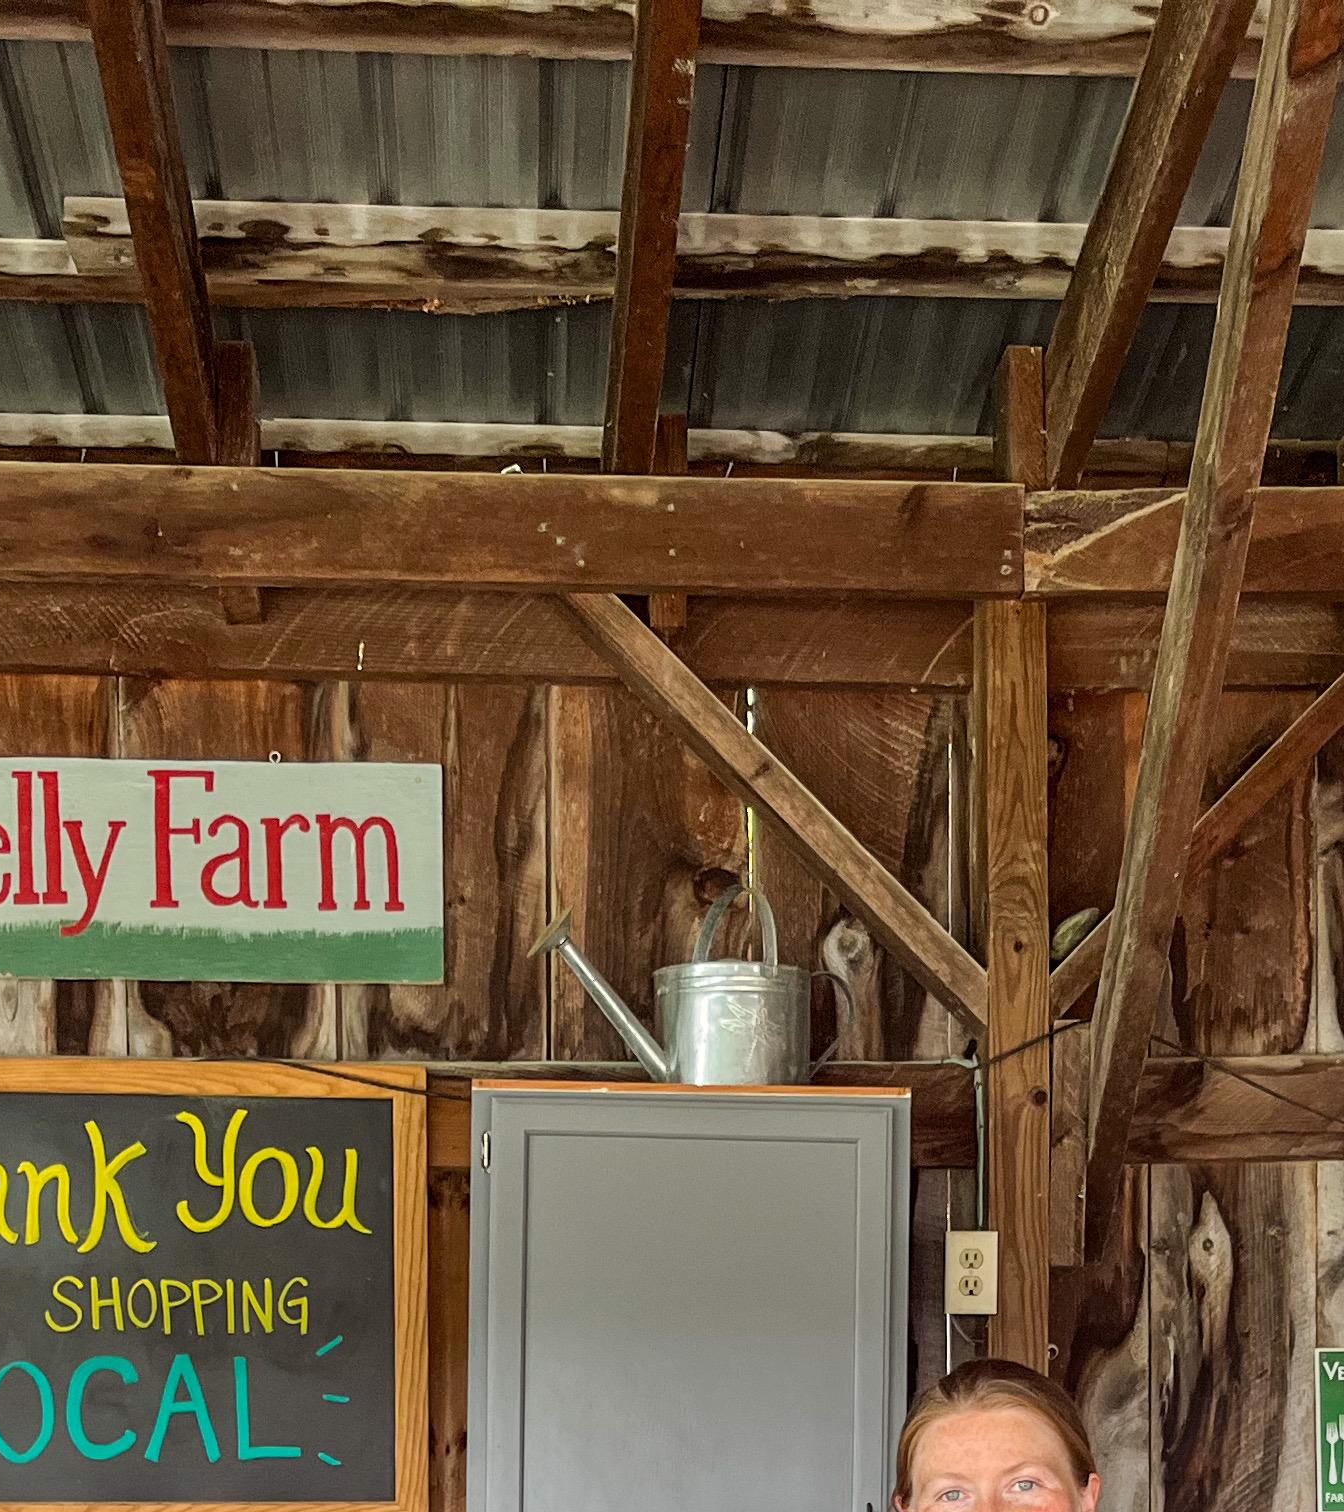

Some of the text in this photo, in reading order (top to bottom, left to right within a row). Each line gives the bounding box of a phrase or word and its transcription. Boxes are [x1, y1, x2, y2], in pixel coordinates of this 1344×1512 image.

[147, 769, 405, 912] Farm
[176, 1109, 373, 1235] You
[45, 1276, 308, 1335] SHOPPING
